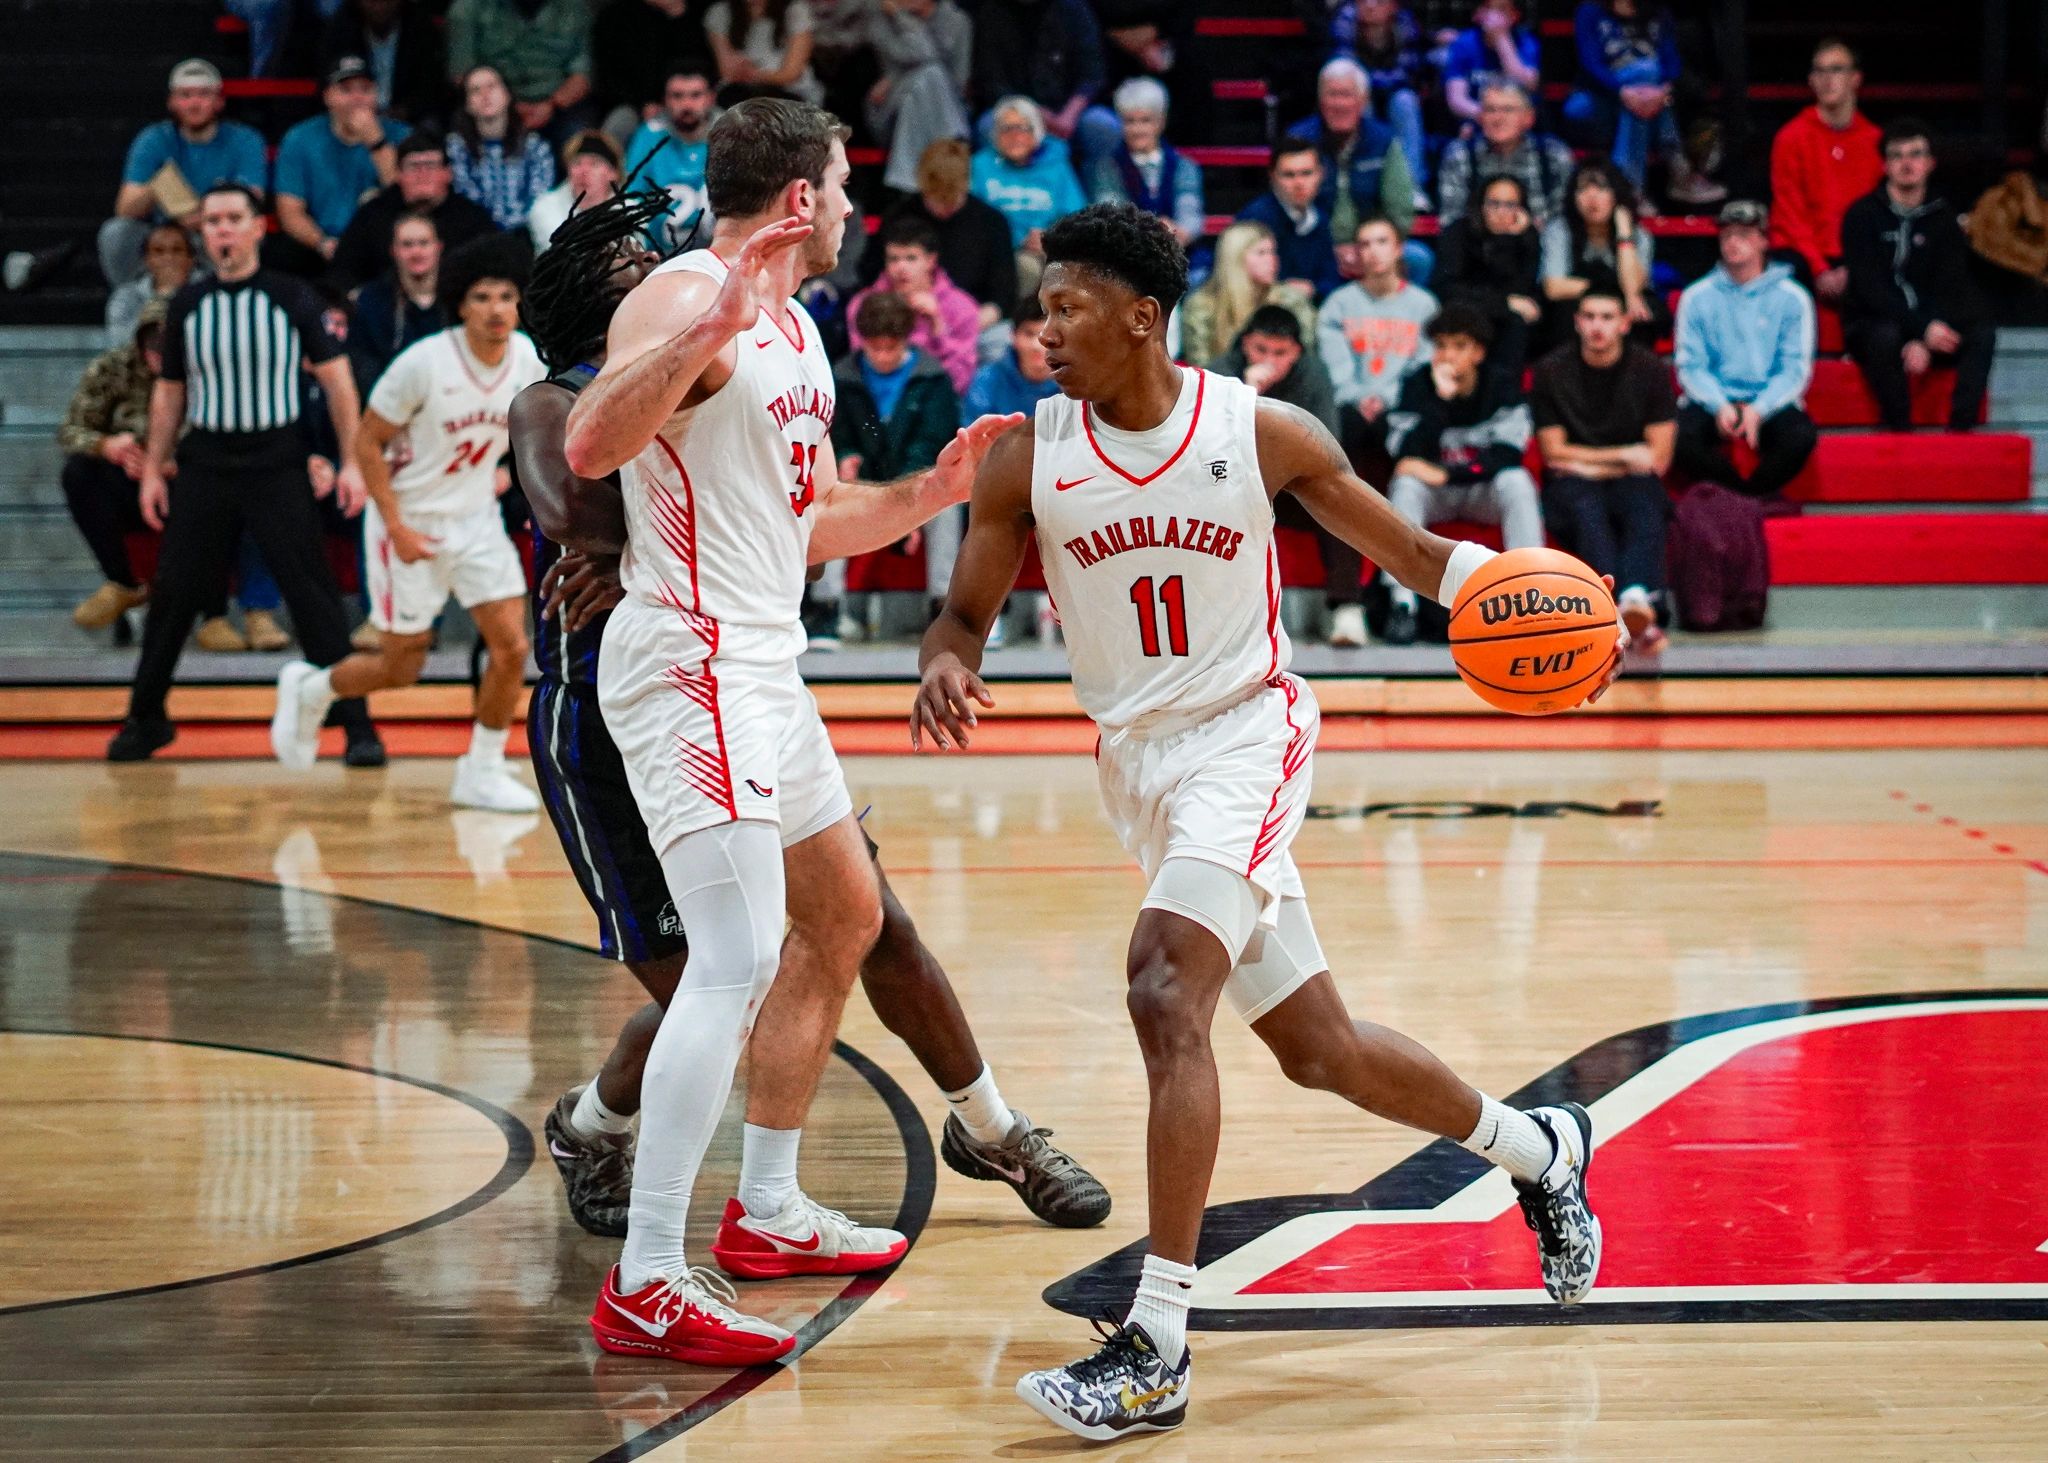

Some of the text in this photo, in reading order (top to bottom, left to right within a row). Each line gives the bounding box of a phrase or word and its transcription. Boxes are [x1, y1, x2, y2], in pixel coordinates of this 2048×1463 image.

[444, 438, 494, 475] 24
[1063, 515, 1244, 570] TRAILBLAZERS
[1129, 574, 1189, 657] 11
[1478, 588, 1593, 626] Wilson
